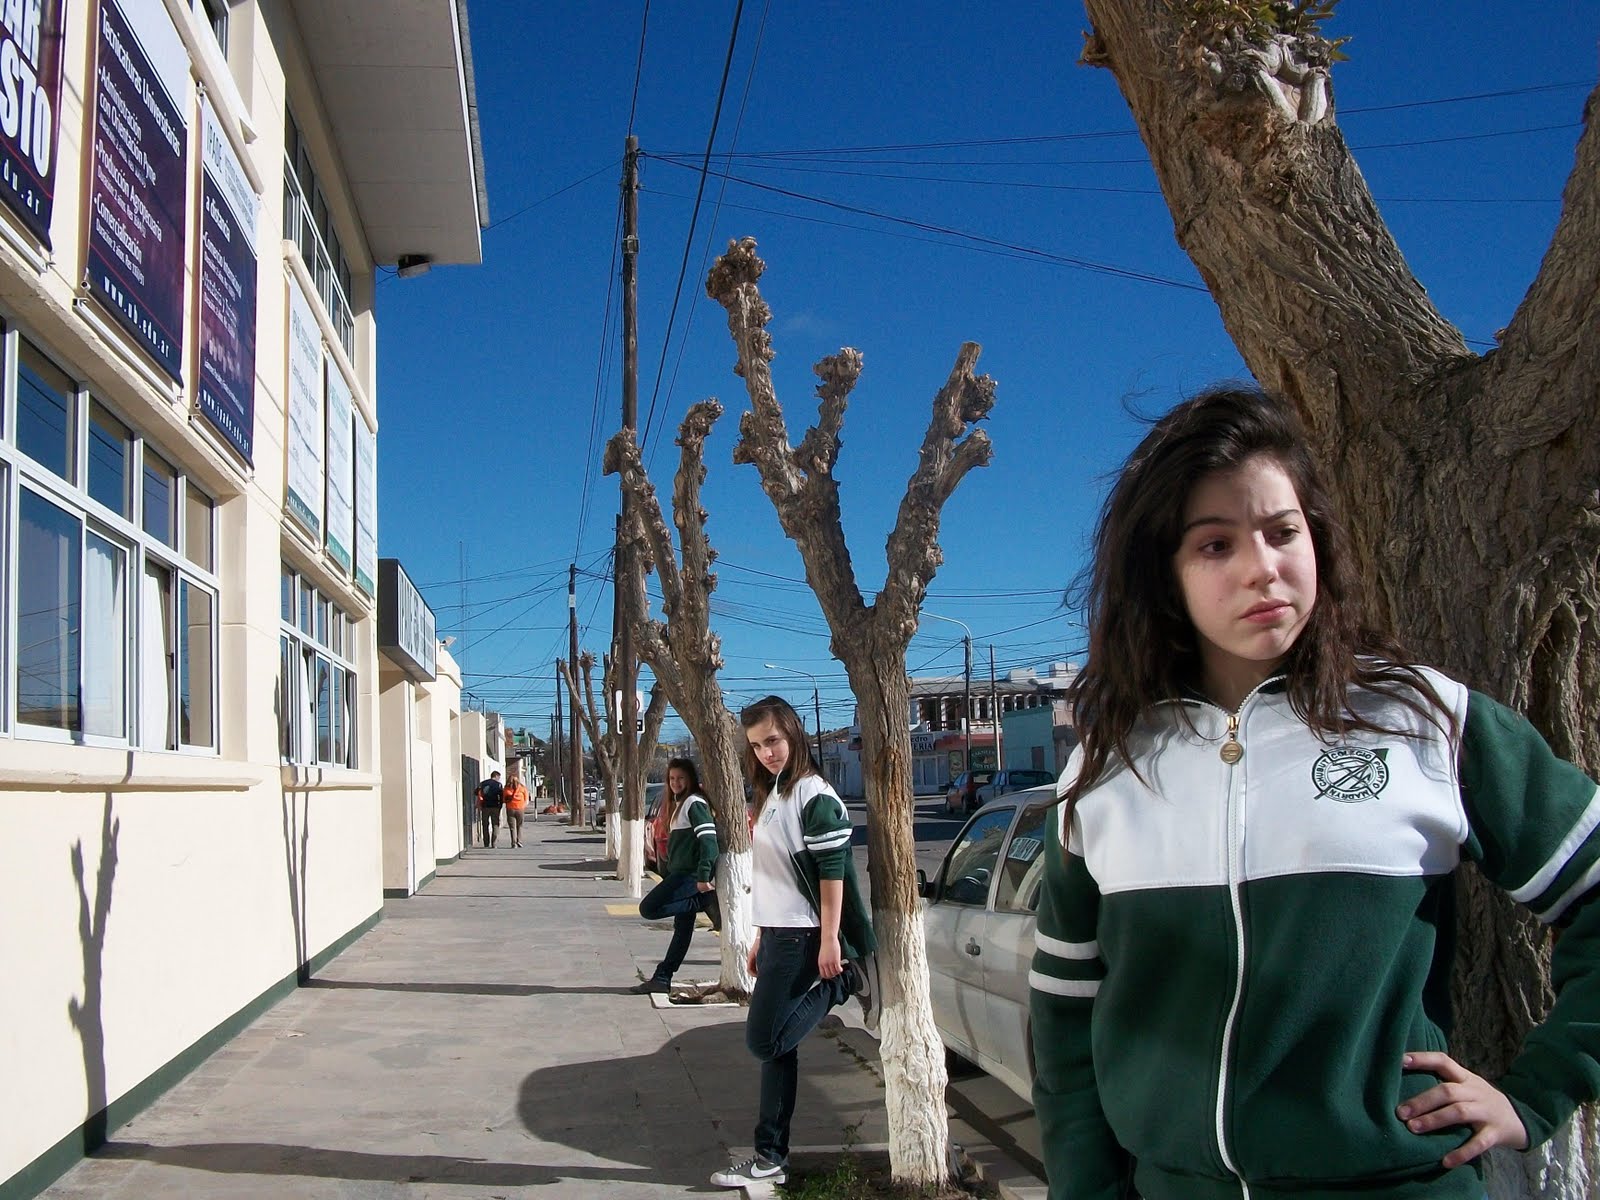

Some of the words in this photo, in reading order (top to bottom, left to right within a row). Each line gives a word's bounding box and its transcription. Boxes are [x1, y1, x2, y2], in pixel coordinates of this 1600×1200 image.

[0, 38, 51, 177] STO
[101, 66, 142, 141] Administración
[102, 6, 142, 95] Tecnicaturas
[143, 78, 181, 157] Universitarias
[100, 92, 111, 118] con
[111, 106, 143, 166] Orientación
[143, 152, 157, 186] Pyme
[98, 139, 130, 198] Producción
[130, 185, 162, 243] Agropecuaria
[210, 198, 230, 243] distancia
[96, 192, 142, 265] Comercialización
[204, 231, 223, 268] Comercio
[104, 276, 169, 358] www.ub.edu.ar
[912, 743, 933, 751] ERIA
[1316, 758, 1329, 787] CHUBUT
[1331, 750, 1372, 759] COLGIO
[1372, 761, 1385, 789] PUERTO
[1329, 789, 1370, 799] MADRYN
